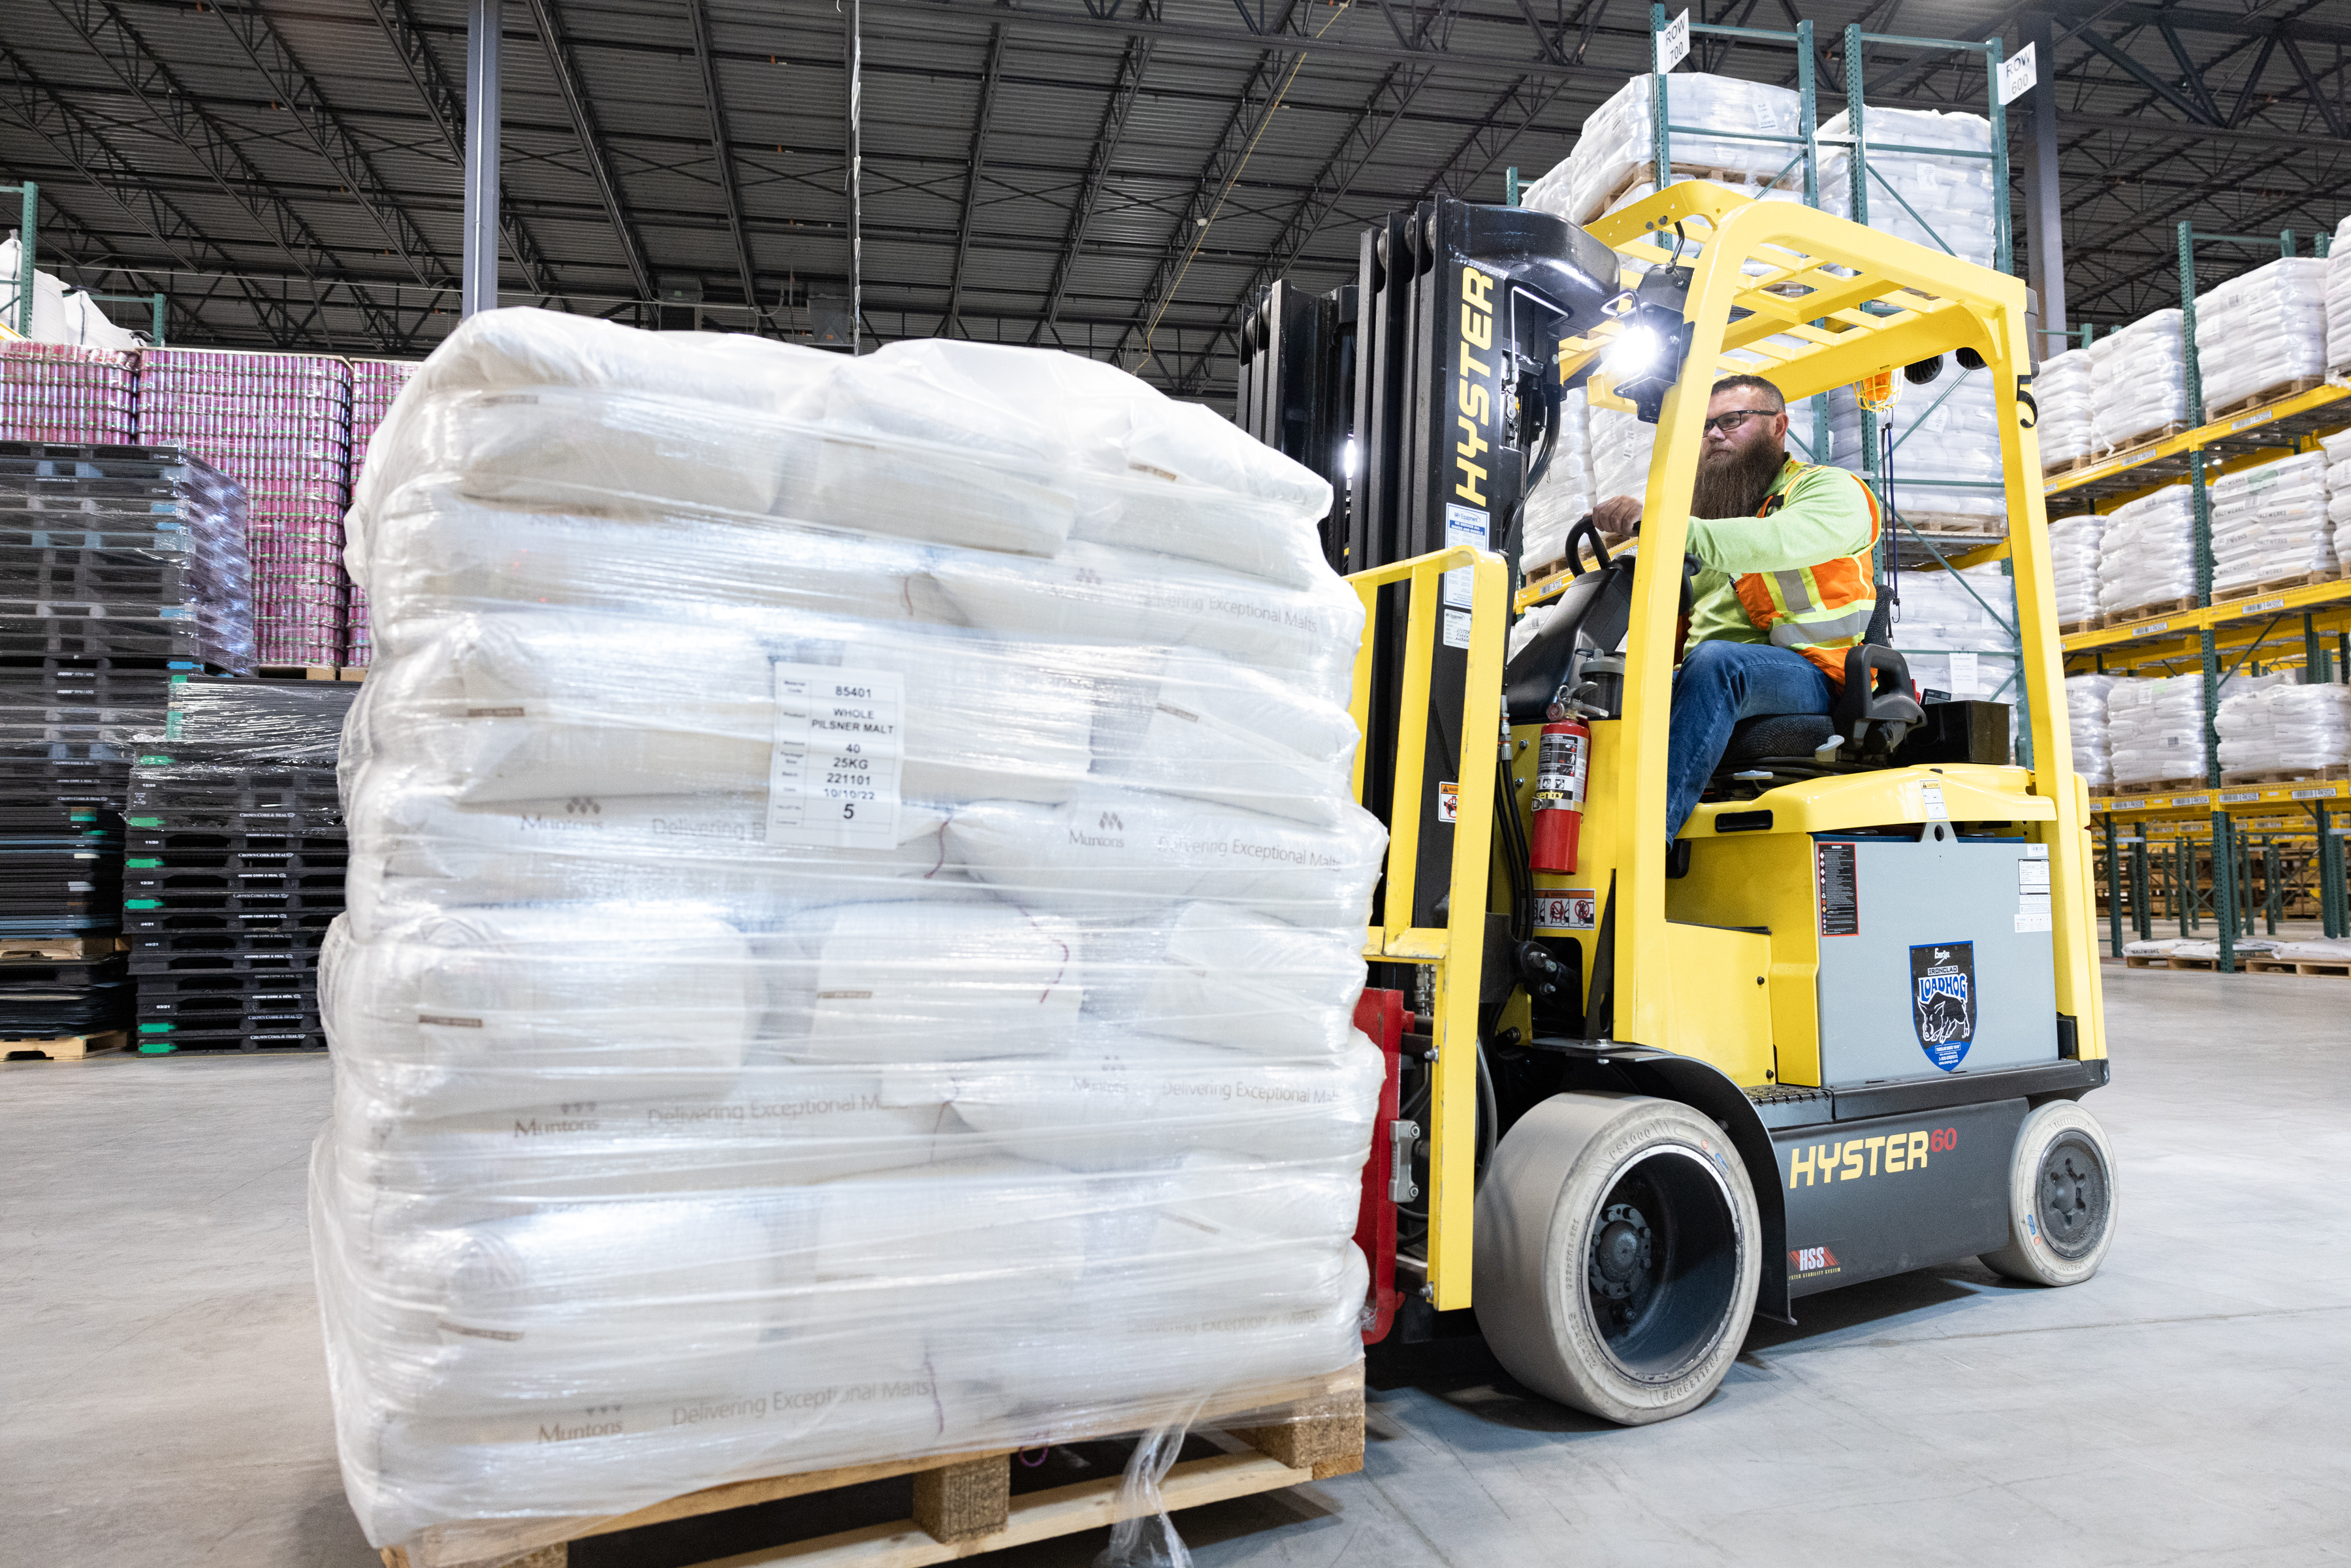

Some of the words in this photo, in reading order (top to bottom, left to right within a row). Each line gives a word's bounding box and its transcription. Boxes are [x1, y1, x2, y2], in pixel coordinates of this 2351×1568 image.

[1666, 16, 1685, 46] ROW
[1670, 41, 1683, 64] 700
[2007, 49, 2030, 78] ROW
[2012, 74, 2028, 95] 600
[1456, 266, 1493, 507] HYSTER
[2017, 375, 2038, 428] 5
[1461, 513, 1478, 522] Equipment
[1209, 596, 1281, 623] Exceptional
[1285, 611, 1317, 633] Malts
[835, 686, 871, 697] 85401
[834, 709, 874, 719] WHOLE
[812, 720, 859, 731] PILSNER
[863, 724, 894, 734] MALT
[846, 744, 860, 754] 40
[833, 757, 868, 769] 25KG
[827, 773, 871, 785] 221101
[824, 788, 874, 800] 10/10/22
[1536, 790, 1563, 799] sentry
[843, 803, 854, 819] 5
[1069, 829, 1124, 848] Muntons
[1232, 839, 1306, 864] Exceptional
[1310, 852, 1341, 872] Malts
[1919, 974, 1968, 1004] LOADHOG
[1162, 1080, 1232, 1100] Delivering
[1237, 1081, 1309, 1102] Exceptional
[648, 1104, 744, 1127] Delivering
[751, 1093, 856, 1119] Exceptional
[514, 1116, 600, 1138] Muntons
[1789, 1130, 1928, 1189] HYSTER
[1930, 1127, 1957, 1152] 60
[1800, 1247, 1825, 1271] HSS
[1200, 1315, 1277, 1333] Exception
[672, 1394, 765, 1426] Delivering
[882, 1377, 931, 1400] Malts
[538, 1418, 622, 1444] Muntons
